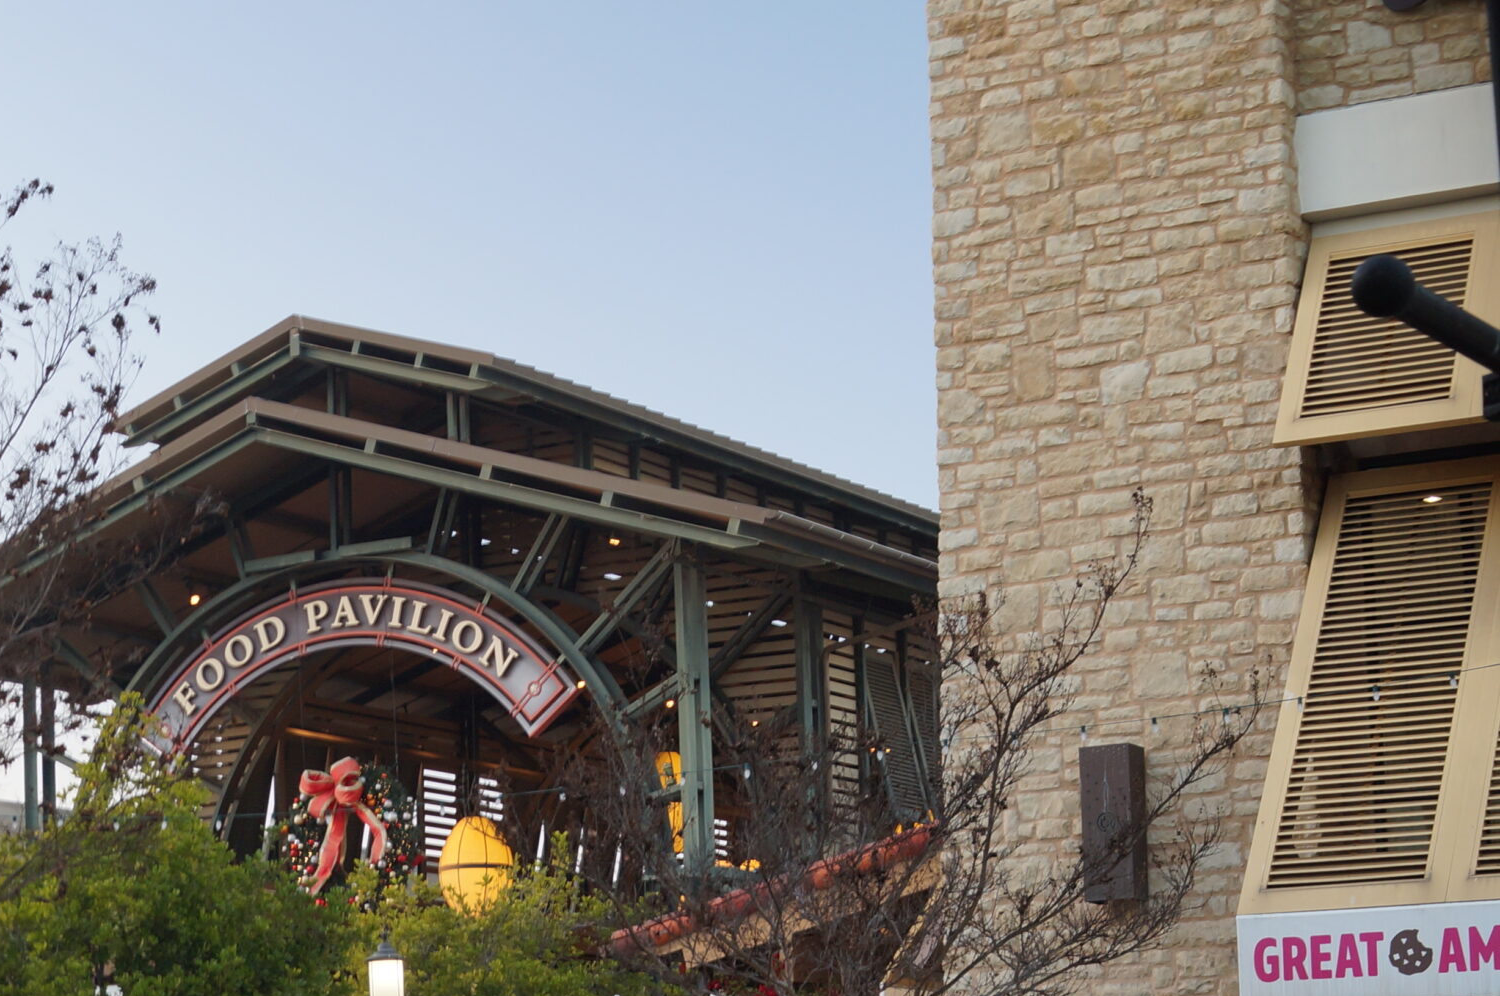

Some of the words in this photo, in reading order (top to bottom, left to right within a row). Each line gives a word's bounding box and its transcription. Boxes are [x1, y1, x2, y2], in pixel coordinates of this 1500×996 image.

[172, 615, 286, 715] FOOD
[302, 594, 519, 678] PAVILION
[1254, 931, 1384, 983] GREAT
